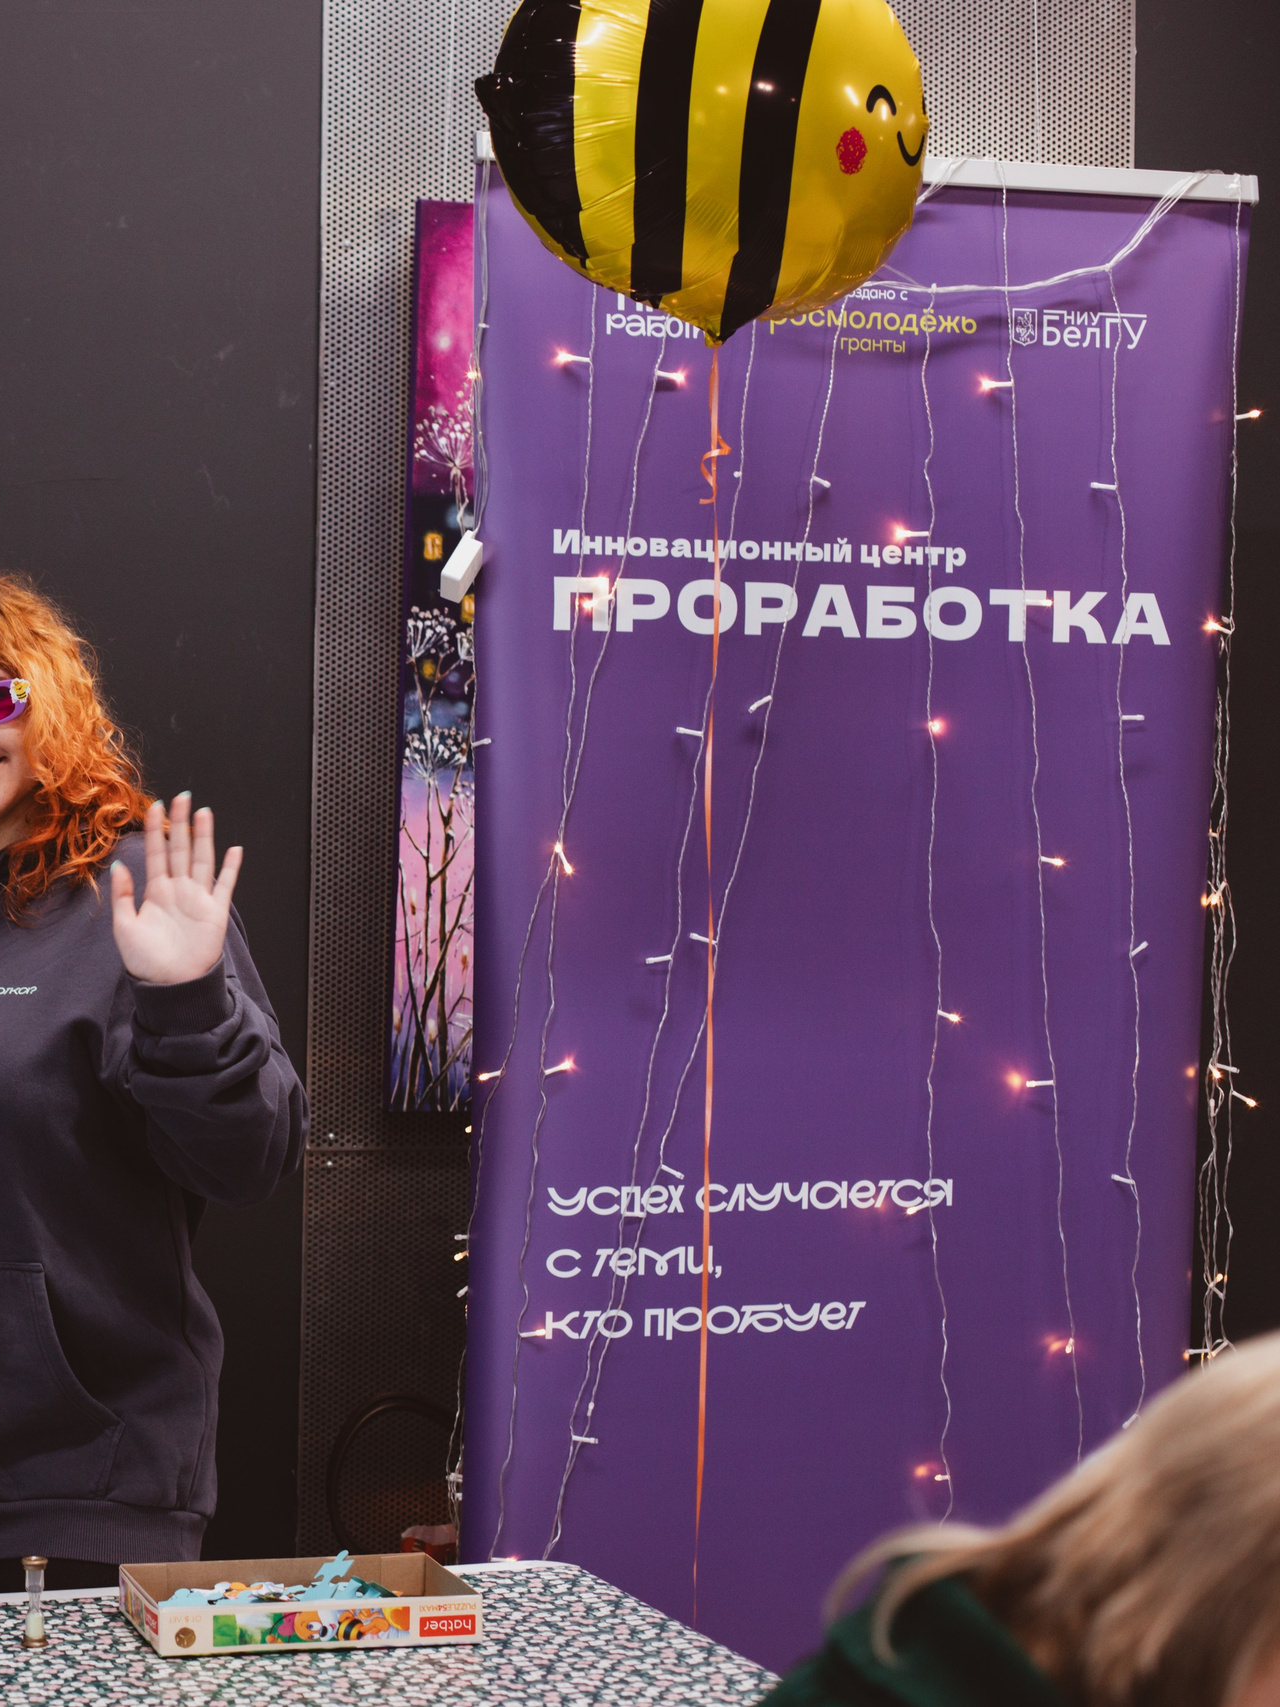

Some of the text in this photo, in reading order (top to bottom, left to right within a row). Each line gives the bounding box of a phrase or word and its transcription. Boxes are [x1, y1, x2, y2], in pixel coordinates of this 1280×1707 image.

[847, 288, 896, 301] оздано
[1042, 314, 1147, 350] БелГУ
[1063, 310, 1101, 326] НИУ
[840, 337, 906, 355] гранты
[553, 529, 967, 574] Инновационный центр
[552, 576, 1172, 646] ПРОРАБОТКА
[695, 1178, 953, 1213] случается
[544, 1301, 867, 1340] кто пробует
[423, 1618, 472, 1632] hatber
